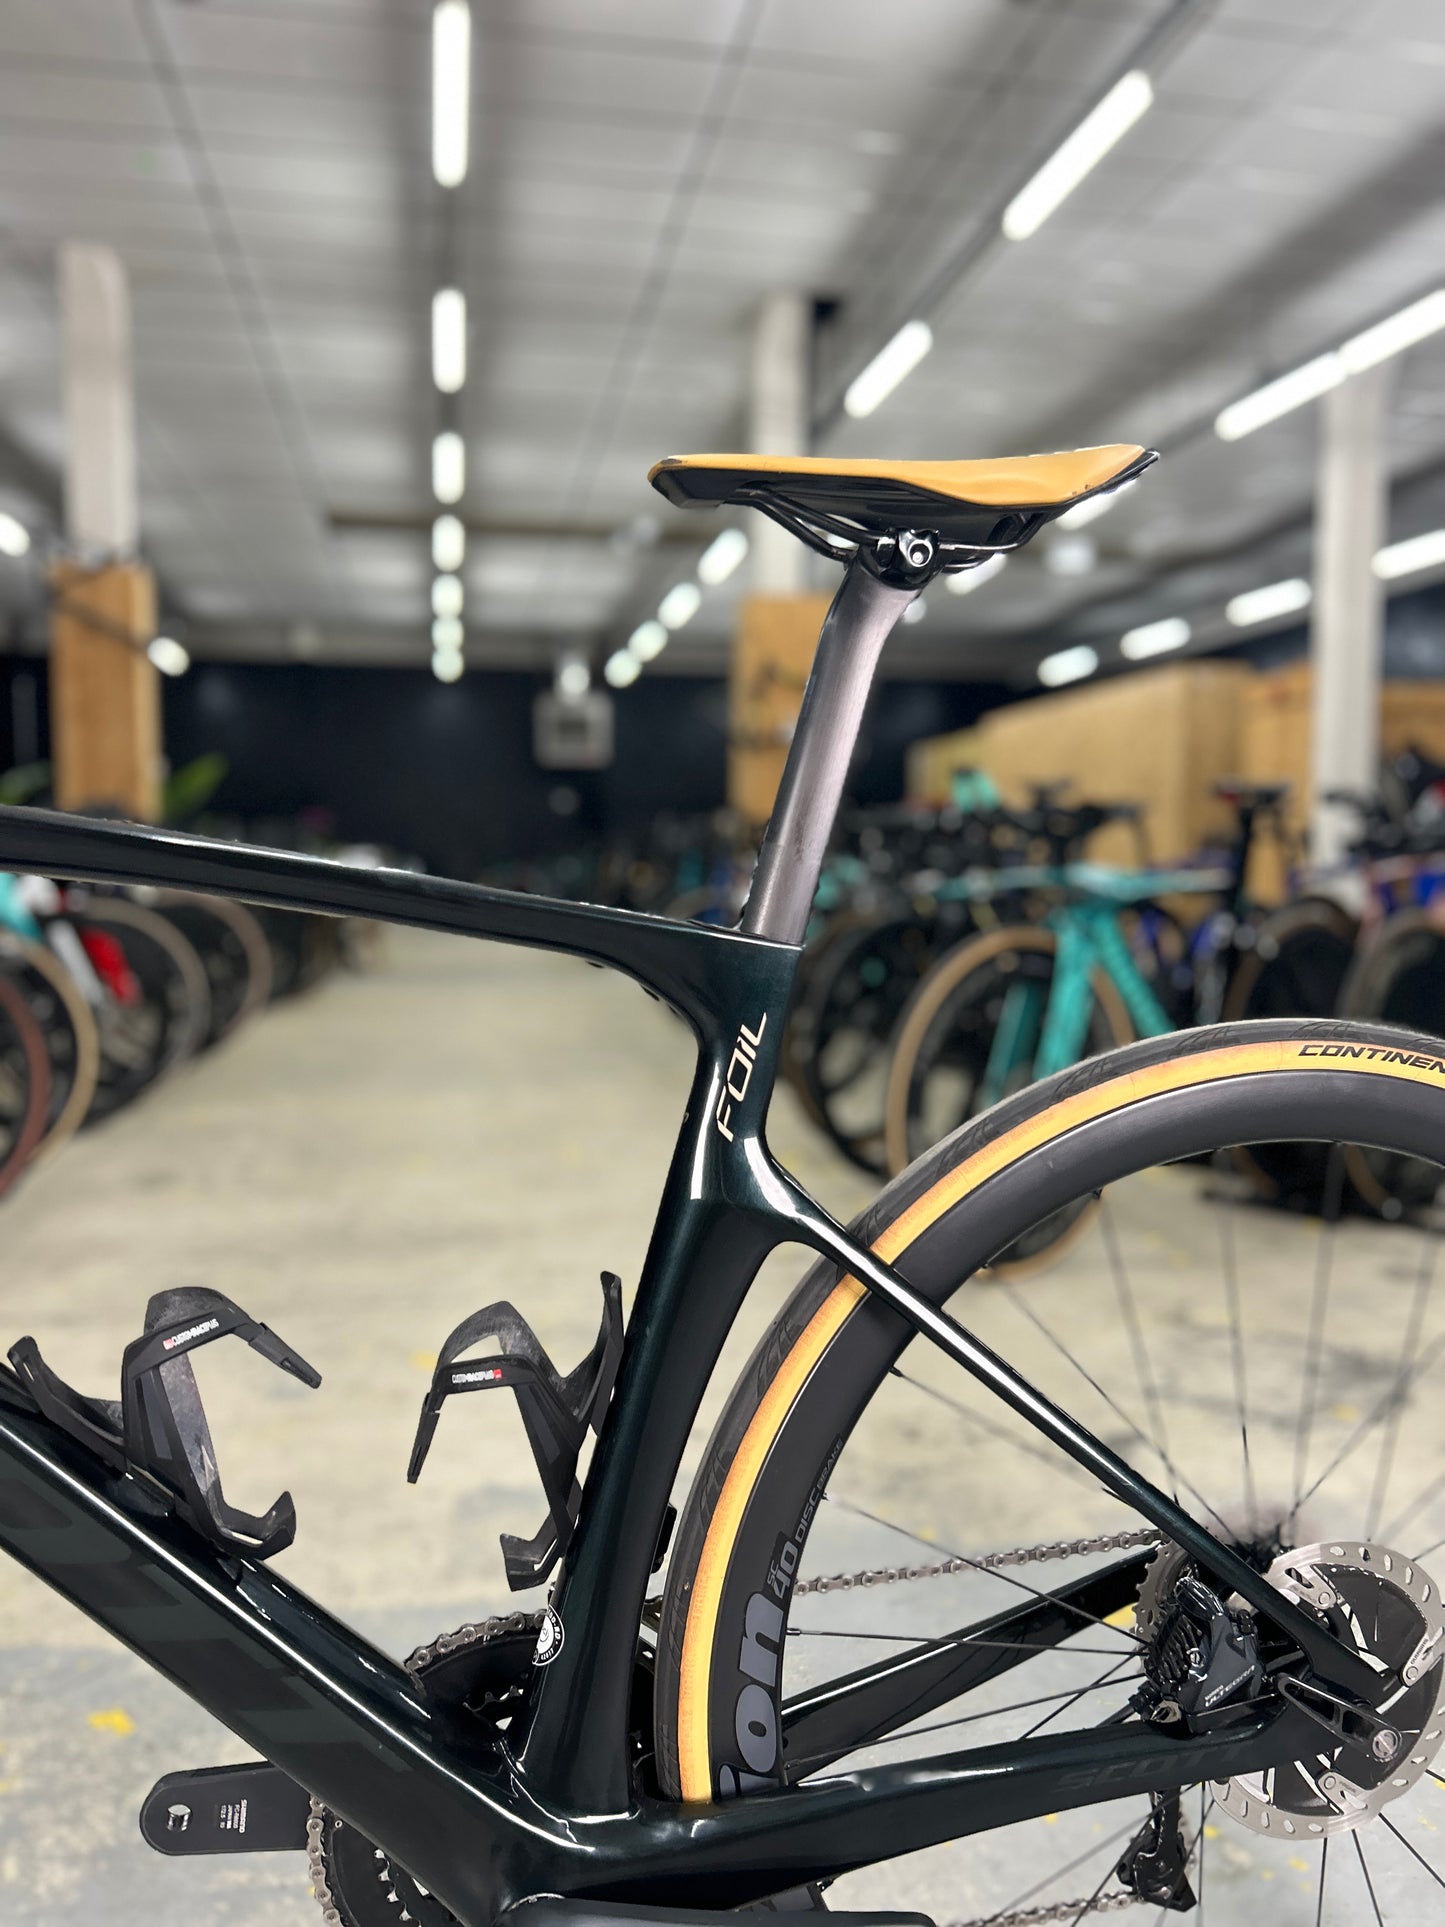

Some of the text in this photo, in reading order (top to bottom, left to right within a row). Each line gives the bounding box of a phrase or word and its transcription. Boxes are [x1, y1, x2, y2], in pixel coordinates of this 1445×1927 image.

[716, 1012, 767, 1142] FOIL
[794, 1487, 821, 1544] DISC
[766, 1559, 779, 1586] SC
[1205, 1664, 1255, 1707] ULTEGRA
[1054, 1742, 1254, 1792] SCOTT
